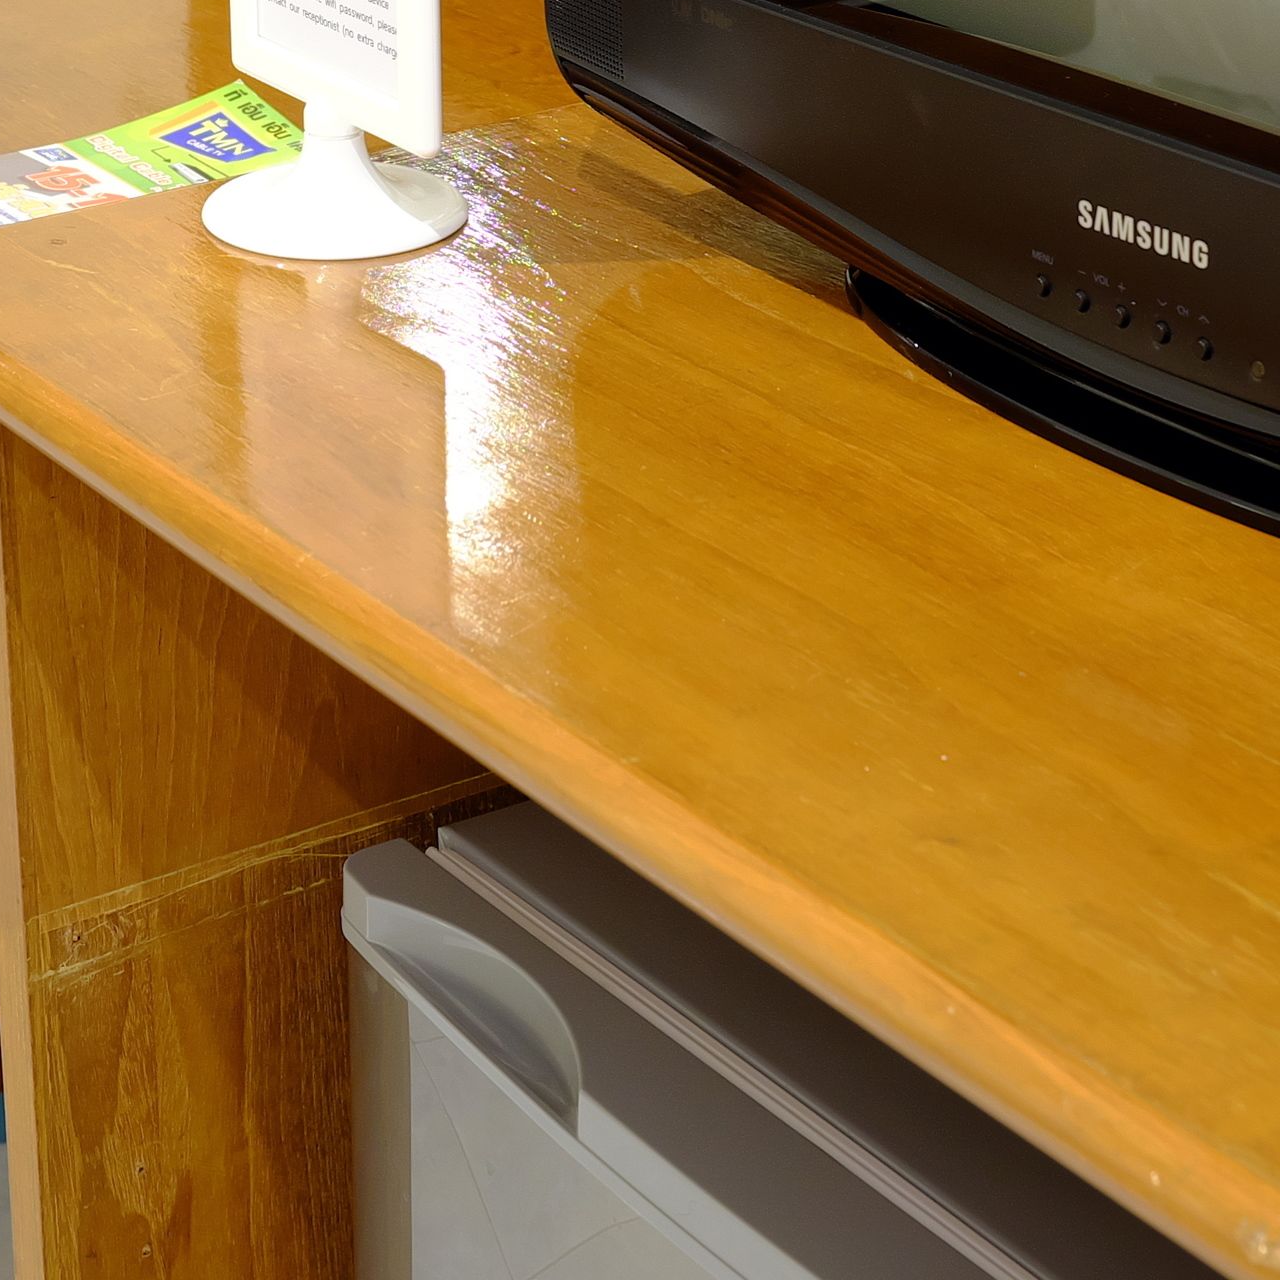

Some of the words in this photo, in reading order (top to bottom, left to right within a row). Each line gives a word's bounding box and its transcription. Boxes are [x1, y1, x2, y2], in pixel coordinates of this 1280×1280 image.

[339, 4, 374, 27] password,
[289, 3, 300, 14] our
[302, 9, 340, 33] receptionist
[342, 25, 354, 38] (no
[357, 33, 374, 48] extra
[377, 41, 397, 60] charg
[224, 89, 248, 102] ที
[186, 139, 212, 153] CABLE
[211, 148, 226, 157] TV
[189, 118, 254, 156] TMN
[87, 133, 140, 164] Digital
[129, 161, 174, 186] Cable
[1077, 199, 1210, 270] SAMSUNG
[1031, 249, 1055, 266] MENU
[1092, 273, 1110, 288] VOL
